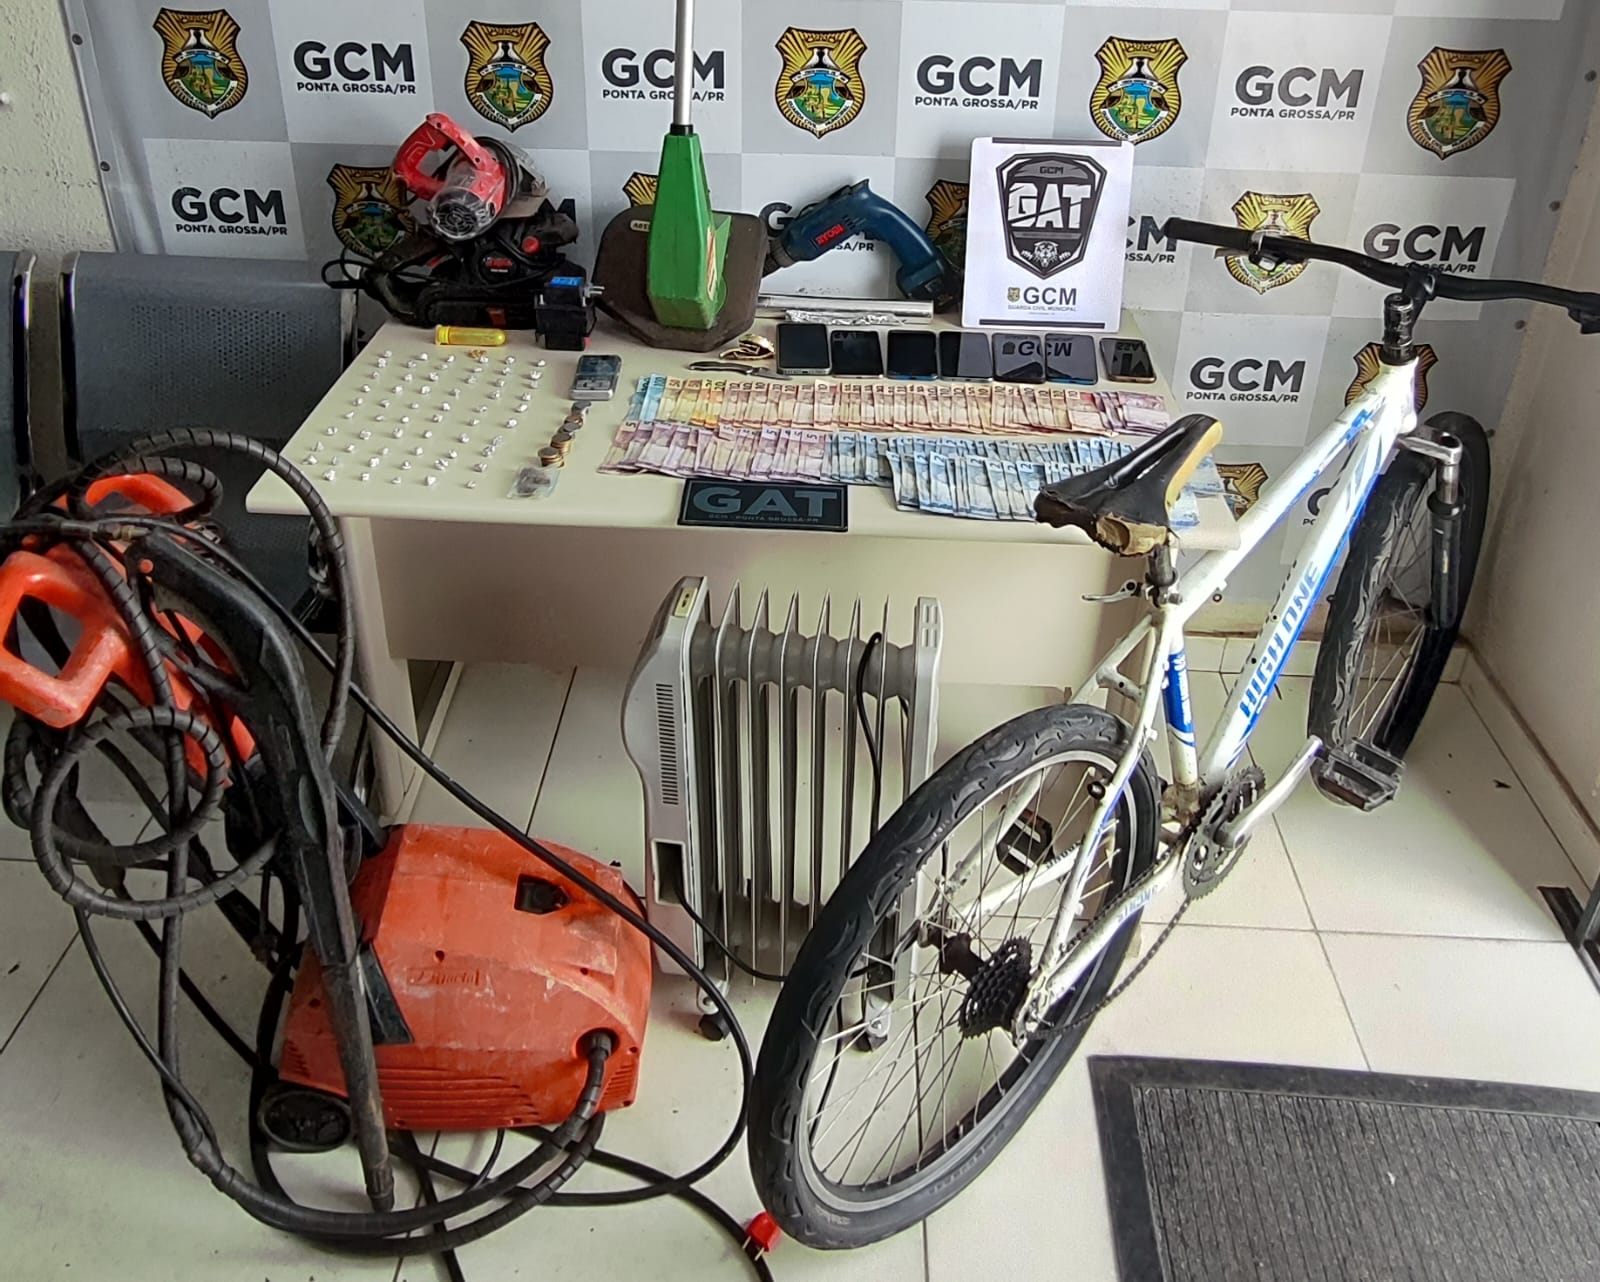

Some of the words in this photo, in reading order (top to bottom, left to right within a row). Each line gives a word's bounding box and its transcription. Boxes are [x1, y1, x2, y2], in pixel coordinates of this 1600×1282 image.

[294, 41, 415, 82] GCM
[601, 48, 724, 88] GCM
[917, 55, 1042, 97] GCM
[297, 82, 339, 92] PONTA
[343, 83, 416, 95] GROSSA/PR
[602, 89, 645, 100] PONTA
[649, 91, 724, 102] GROA/PR
[1236, 66, 1364, 108] GCM
[915, 96, 958, 106] PONTA
[962, 98, 1038, 110] GROSSA/PR
[1231, 107, 1274, 118] PONTA
[1279, 109, 1355, 120] GROSSA/PR
[1040, 166, 1064, 175] GCM
[172, 187, 286, 225] GCM
[1008, 182, 1092, 229] GAT
[175, 224, 216, 233] PONTA
[219, 225, 288, 236] GROSSA/PR
[1364, 224, 1486, 262] GCM
[1125, 252, 1175, 264] SSA/PR
[1023, 286, 1077, 305] GCM
[1190, 357, 1306, 393] GCM
[1186, 391, 1226, 401] PONTA
[1229, 393, 1299, 403] GROSSA/PR
[693, 487, 837, 517] GAT
[1240, 632, 1284, 718] HIGH
[1282, 561, 1320, 633] ONE
